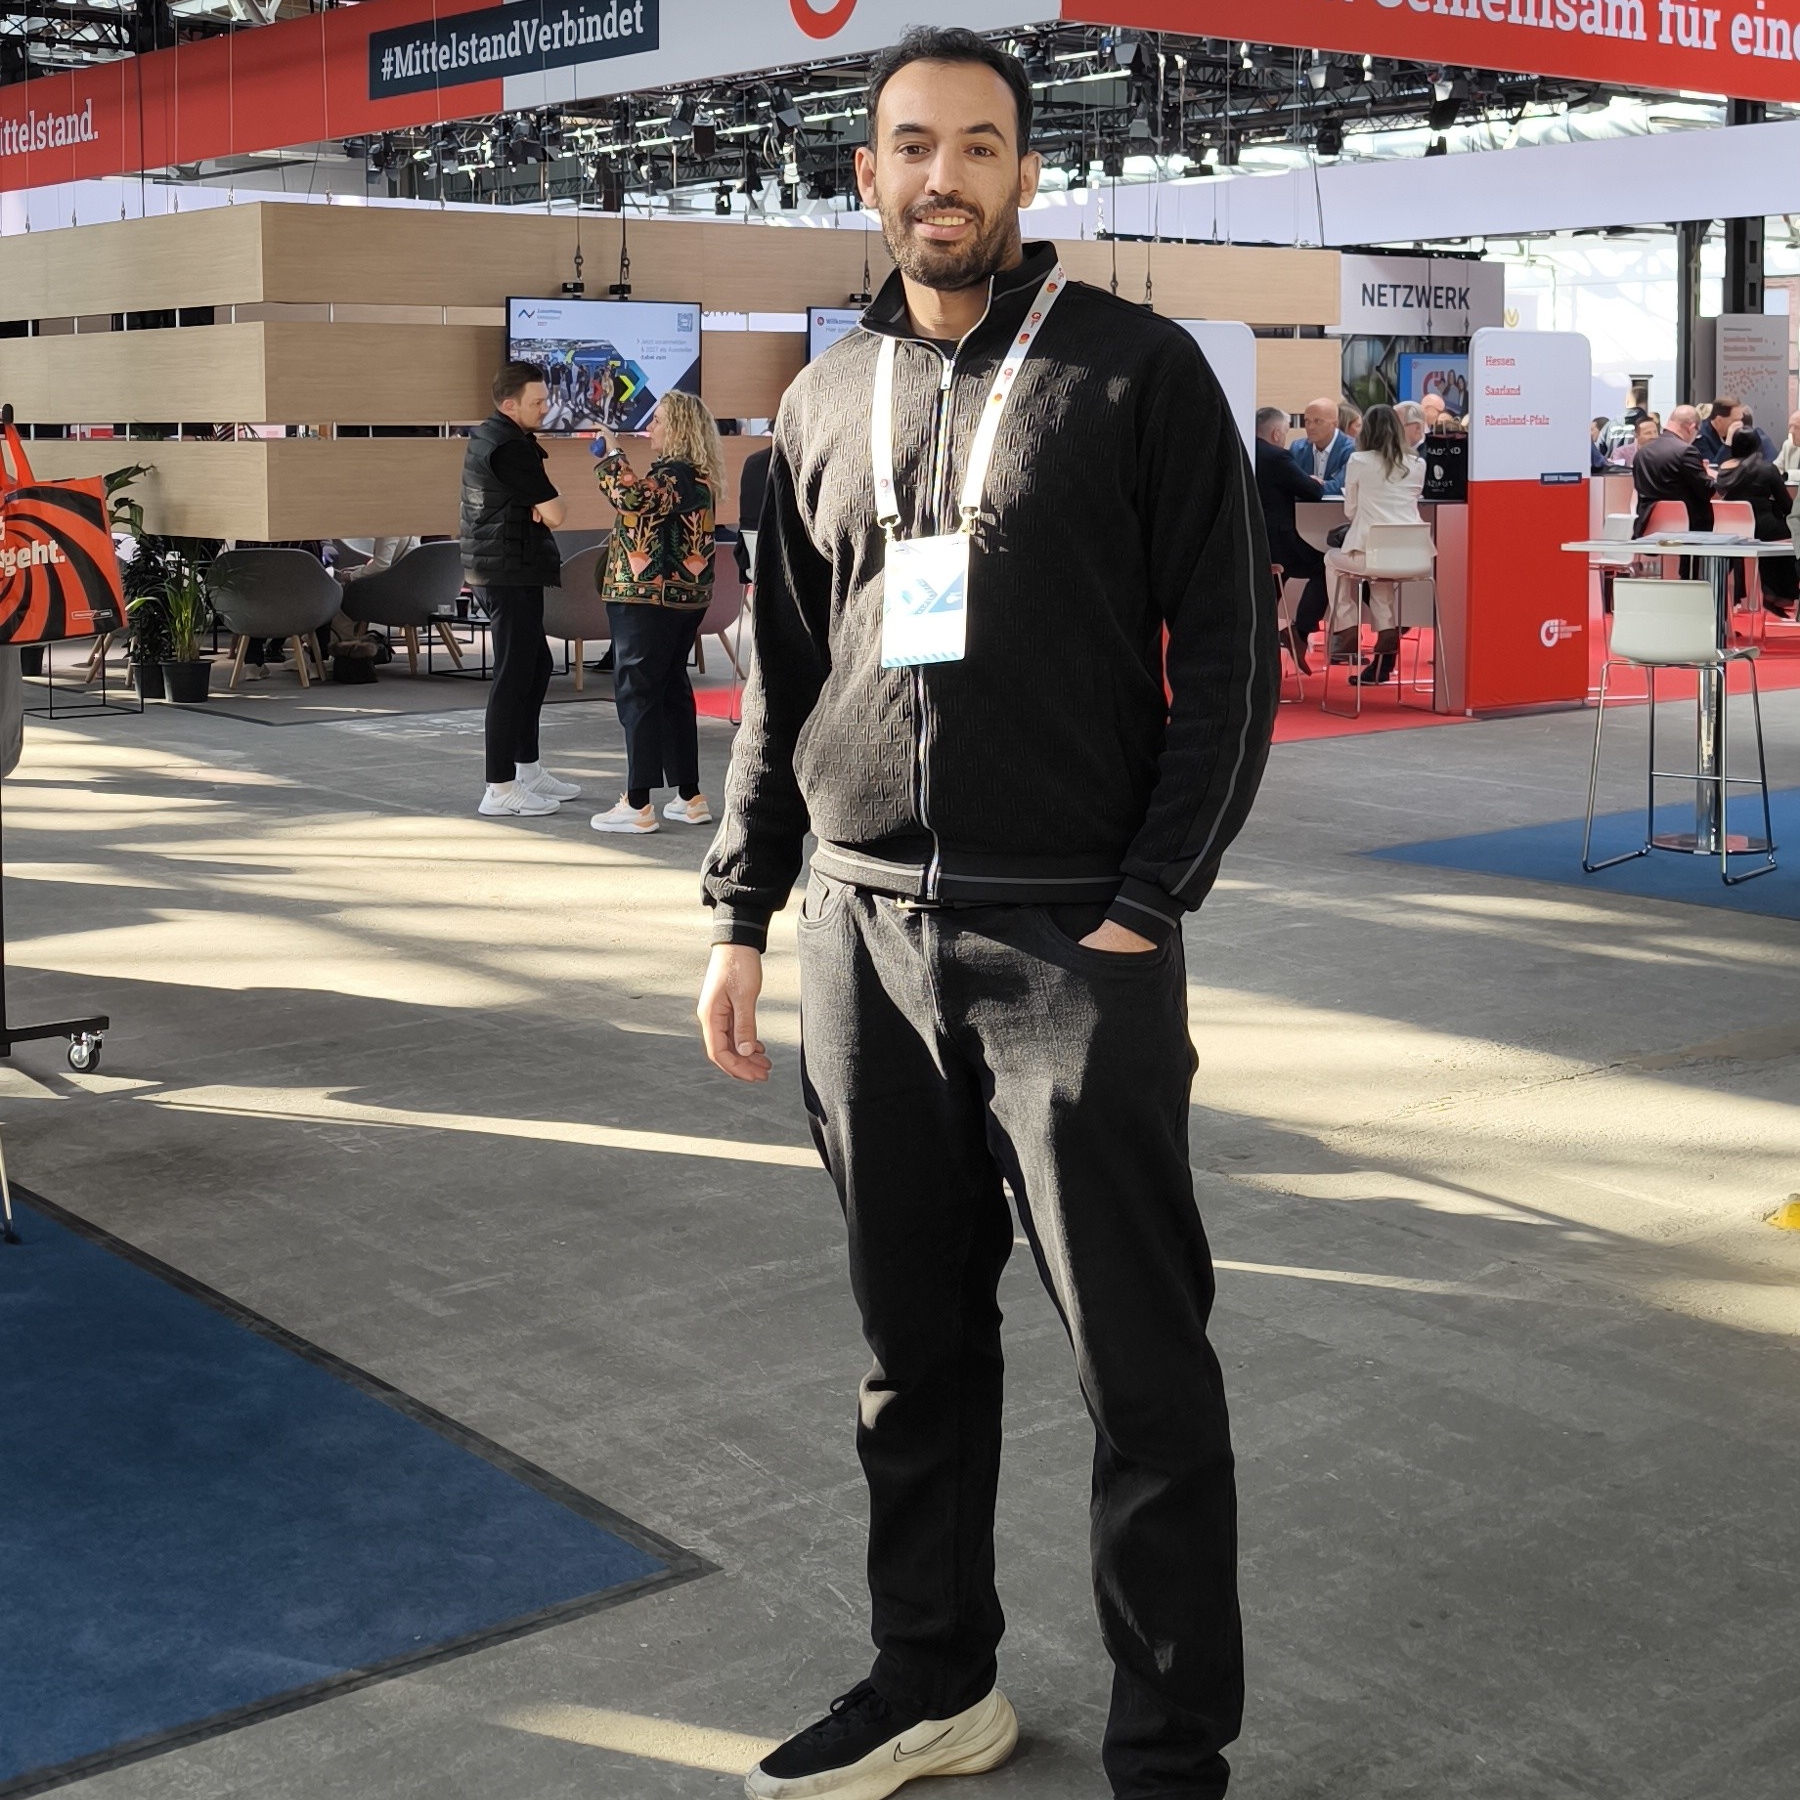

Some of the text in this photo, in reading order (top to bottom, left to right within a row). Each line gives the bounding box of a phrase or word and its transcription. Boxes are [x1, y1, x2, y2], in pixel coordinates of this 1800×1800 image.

[1375, 0, 1648, 41] einsam
[381, 0, 645, 81] #MittelstandVerbindet
[1361, 283, 1470, 310] NETZWERK
[1485, 355, 1516, 367] Hessen
[1485, 385, 1521, 396] Saarland
[1484, 414, 1550, 426] Rheinland-Pfalz
